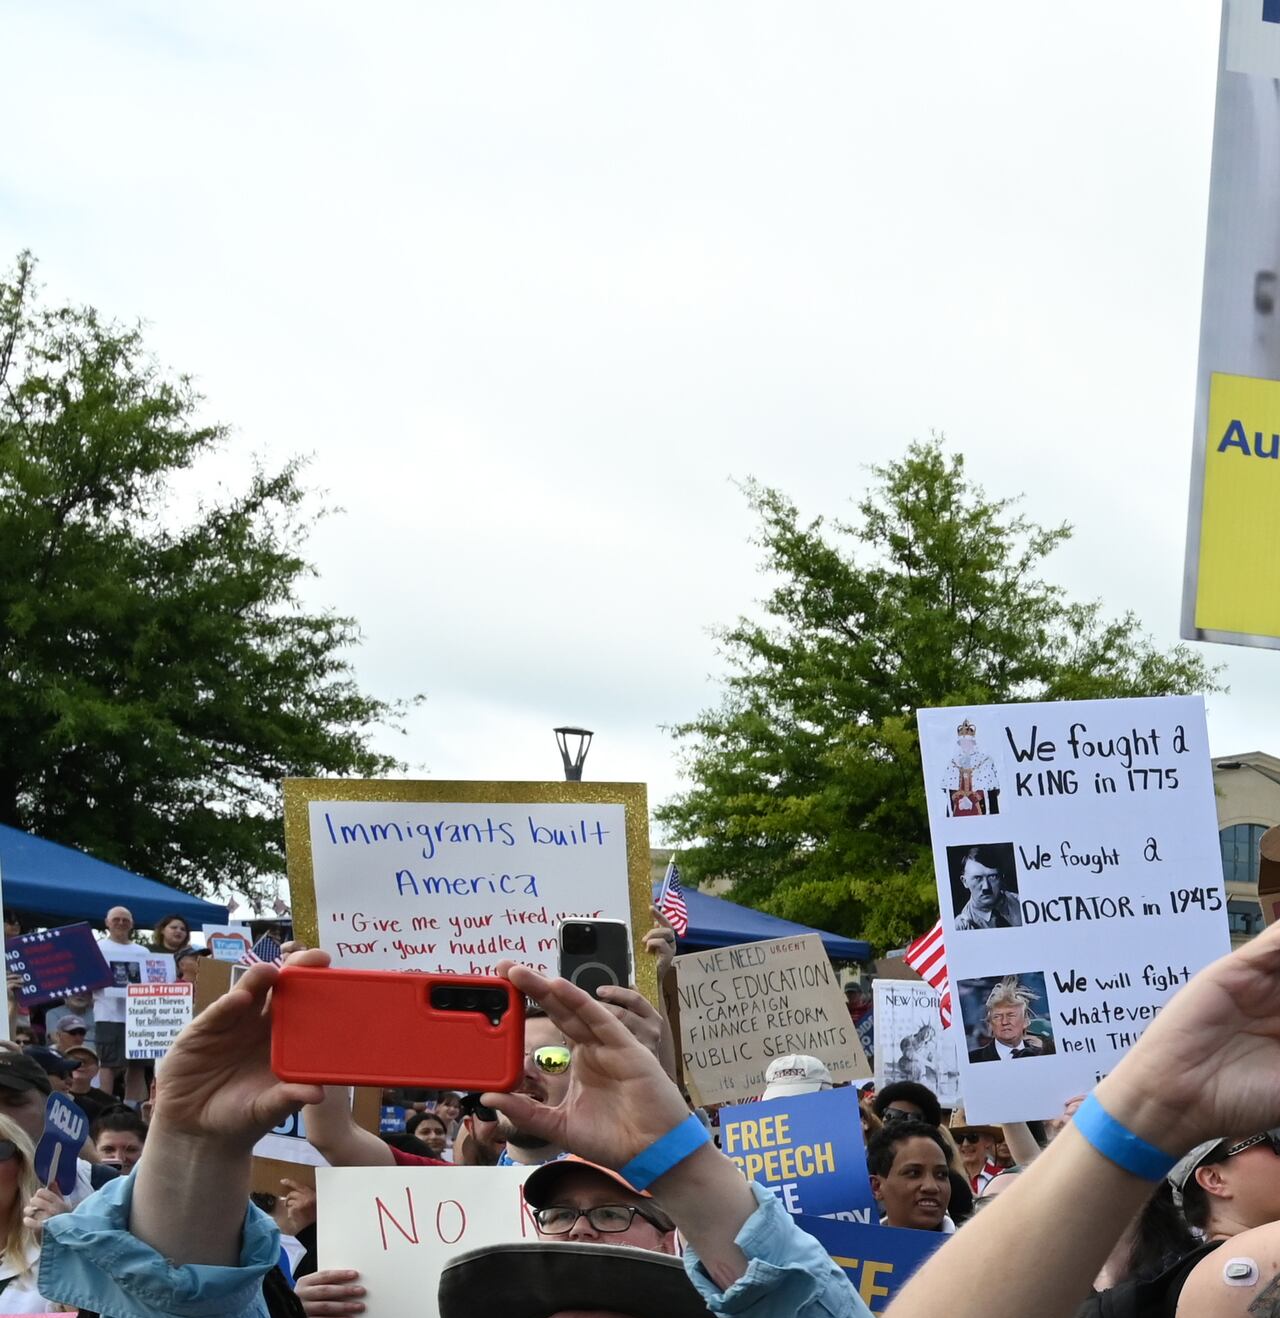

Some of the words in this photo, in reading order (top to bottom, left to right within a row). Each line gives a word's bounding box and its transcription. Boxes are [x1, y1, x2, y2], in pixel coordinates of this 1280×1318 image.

[1005, 726, 1056, 763] We
[1068, 723, 1160, 768] fought
[1173, 725, 1190, 754] a
[1016, 769, 1078, 797] KING
[1094, 772, 1116, 794] in
[1128, 769, 1179, 792] 1775
[325, 813, 515, 859] Immigrants
[528, 816, 610, 846] built
[1019, 844, 1051, 870] We
[1061, 841, 1120, 874] fought
[1144, 837, 1162, 862] a
[395, 870, 540, 897] America
[412, 916, 440, 930] me
[450, 914, 493, 937] your
[500, 907, 556, 926] tired,
[1022, 896, 1135, 925] DICTATOR
[1143, 896, 1160, 916] in
[393, 940, 436, 960] your
[450, 934, 527, 956] huddled
[698, 953, 728, 974] WE
[730, 943, 766, 969] NEED
[770, 940, 807, 954] URGENT
[734, 961, 830, 1000] EDUCATION
[1054, 969, 1087, 993] We
[1095, 972, 1131, 991] will
[1142, 964, 1191, 992] fight
[128, 1008, 156, 1018] Stealing
[706, 996, 789, 1022] CAMPAIGN
[886, 995, 911, 1006] NEW
[690, 1017, 758, 1043] FINANCE
[767, 1007, 829, 1028] REFORM
[683, 1042, 752, 1071] PUBLIC
[763, 1027, 847, 1057] SERVANTS
[1062, 1035, 1096, 1053] hell
[50, 1099, 84, 1141] ACLU
[725, 1113, 791, 1153] FREE
[730, 1142, 836, 1183] SPEECH
[375, 1187, 467, 1251] NO
